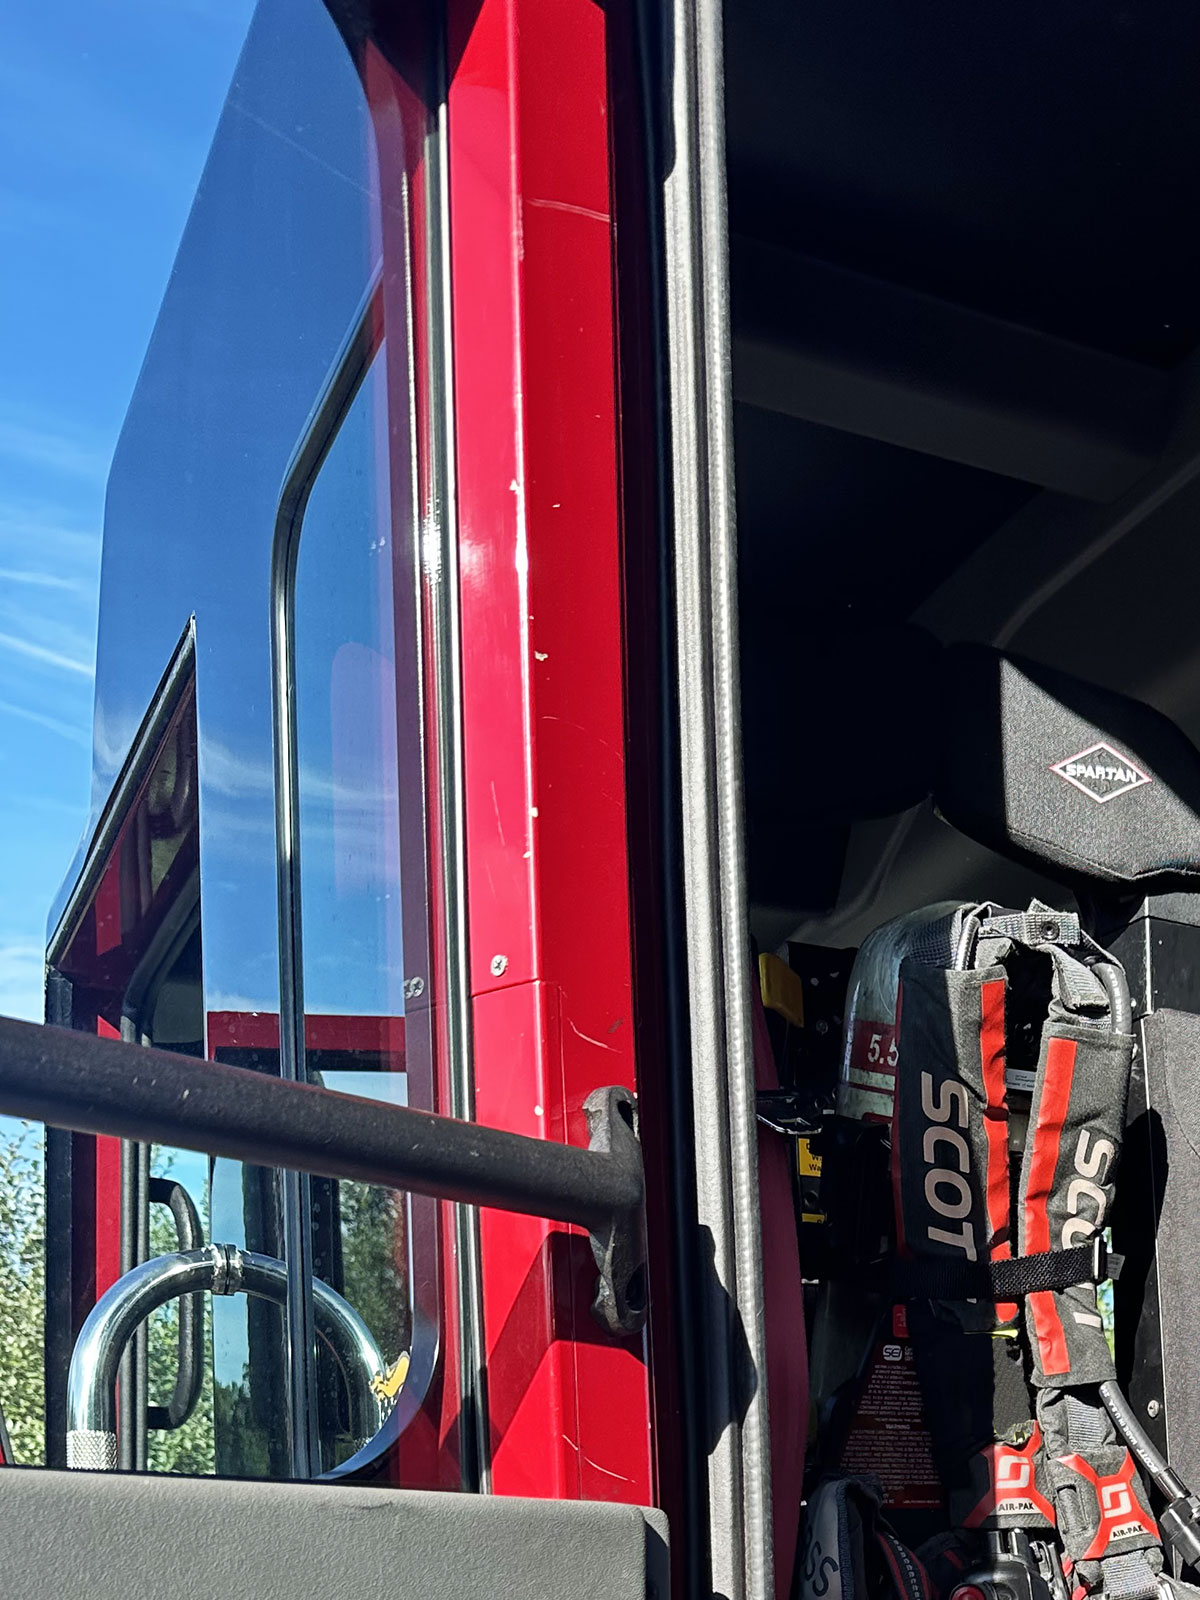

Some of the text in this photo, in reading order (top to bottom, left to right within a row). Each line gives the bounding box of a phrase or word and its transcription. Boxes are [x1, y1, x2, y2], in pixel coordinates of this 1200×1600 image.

[1065, 763, 1137, 783] SPARTAN
[921, 1071, 977, 1303] SCOT
[1123, 1427, 1138, 1445] MADE
[1136, 1448, 1159, 1473] SCOTT
[999, 1502, 1035, 1512] AIR-PAK
[1112, 1525, 1144, 1538] AIR-PAK
